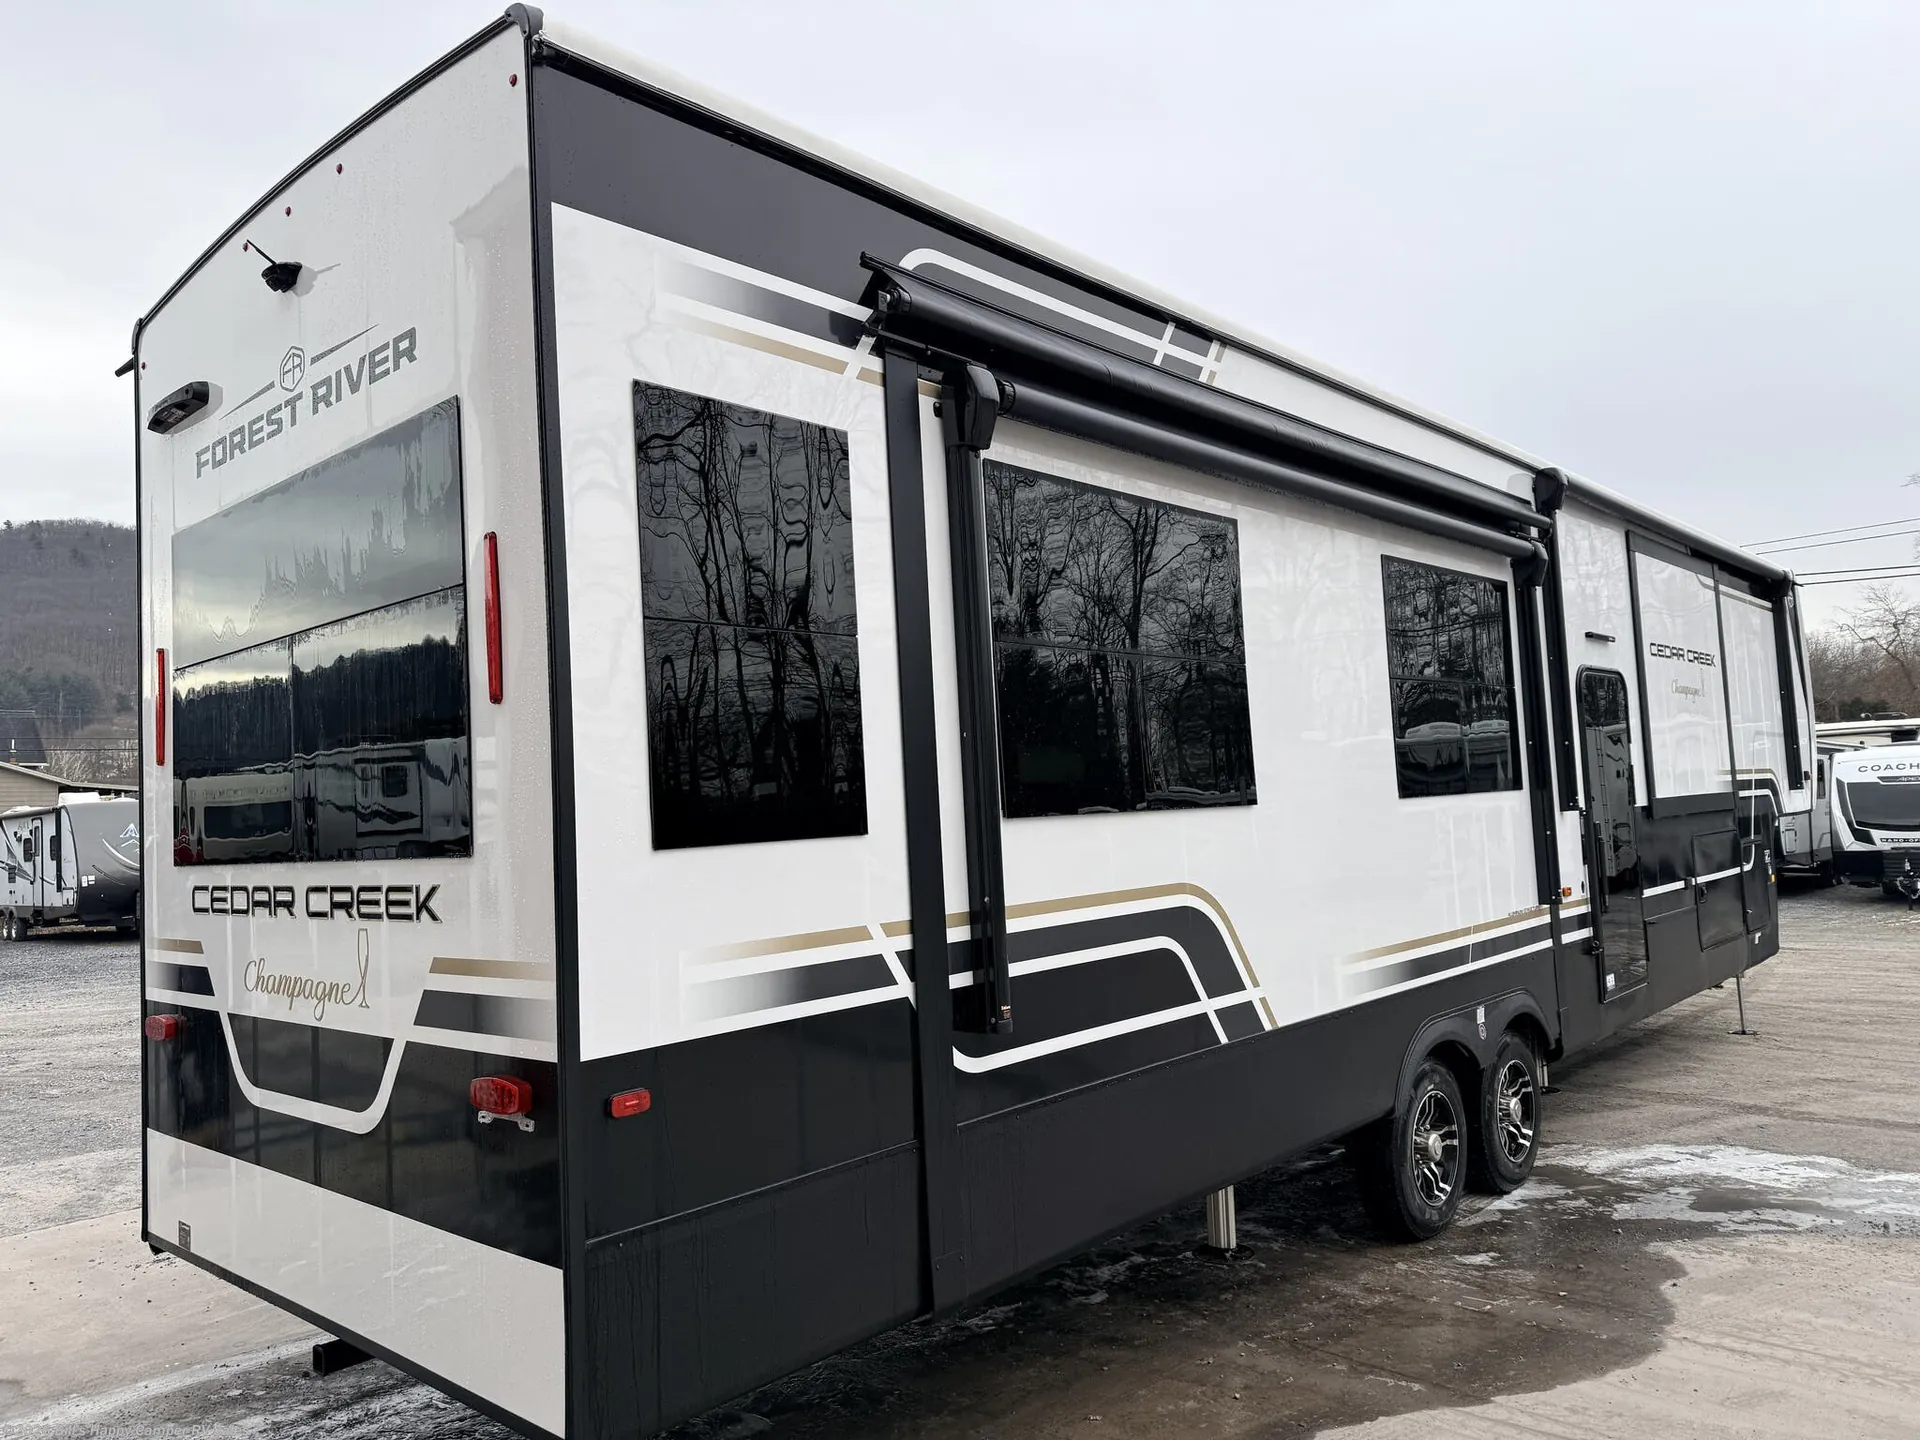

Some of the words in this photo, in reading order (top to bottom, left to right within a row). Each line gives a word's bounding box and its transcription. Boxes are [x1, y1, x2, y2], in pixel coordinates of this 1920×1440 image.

[195, 391, 304, 479] FOREST
[310, 327, 418, 416] RIVER
[1650, 642, 1686, 661] CEDAR
[1687, 649, 1716, 667] CREEK
[191, 884, 297, 919] CEDAR
[305, 884, 443, 923] CREEK
[243, 956, 358, 1022] Champagne
